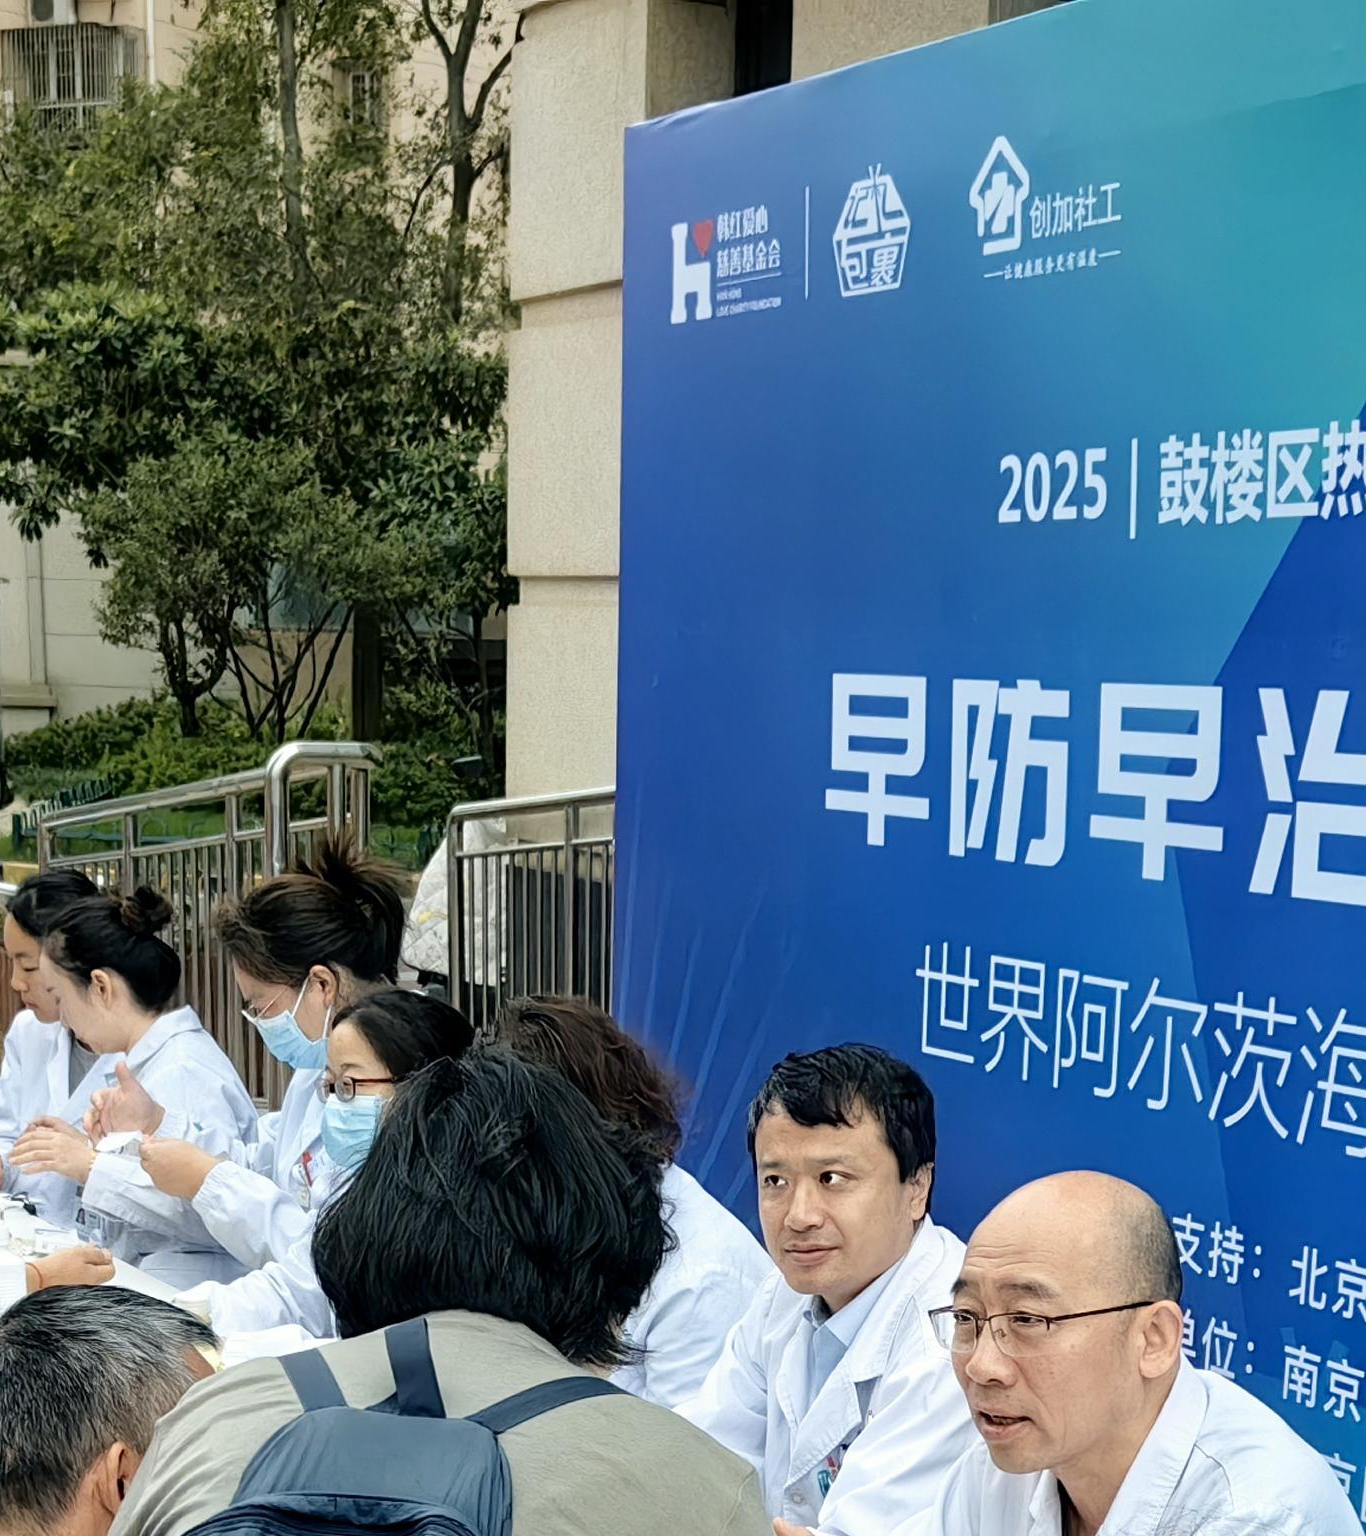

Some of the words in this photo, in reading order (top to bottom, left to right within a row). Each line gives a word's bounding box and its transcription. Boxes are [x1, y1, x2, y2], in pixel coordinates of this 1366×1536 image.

[1029, 182, 1122, 240] 创加社工
[716, 239, 782, 278] 慈善基金会
[997, 448, 1108, 524] 2025
